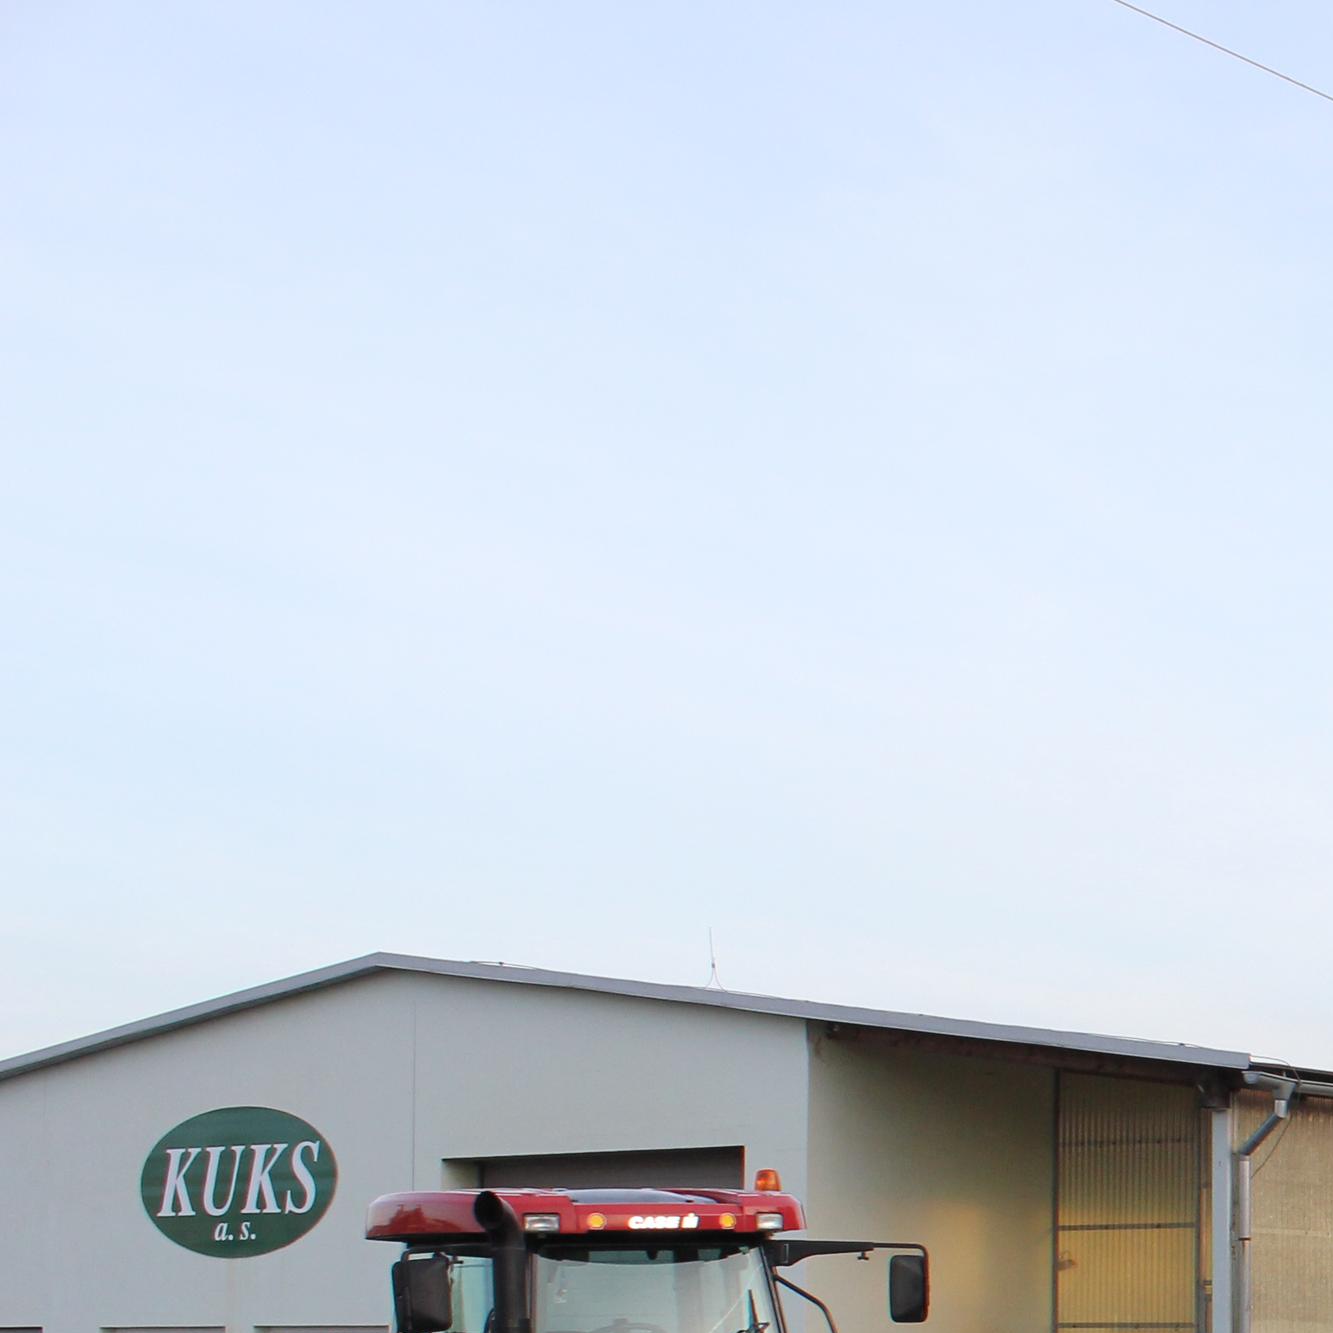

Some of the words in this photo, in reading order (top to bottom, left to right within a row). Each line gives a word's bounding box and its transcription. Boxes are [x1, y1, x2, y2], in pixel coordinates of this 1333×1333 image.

[156, 1140, 320, 1217] KUKS
[213, 1222, 234, 1241] a.
[240, 1221, 256, 1240] s.
[628, 1215, 680, 1229] CASE
